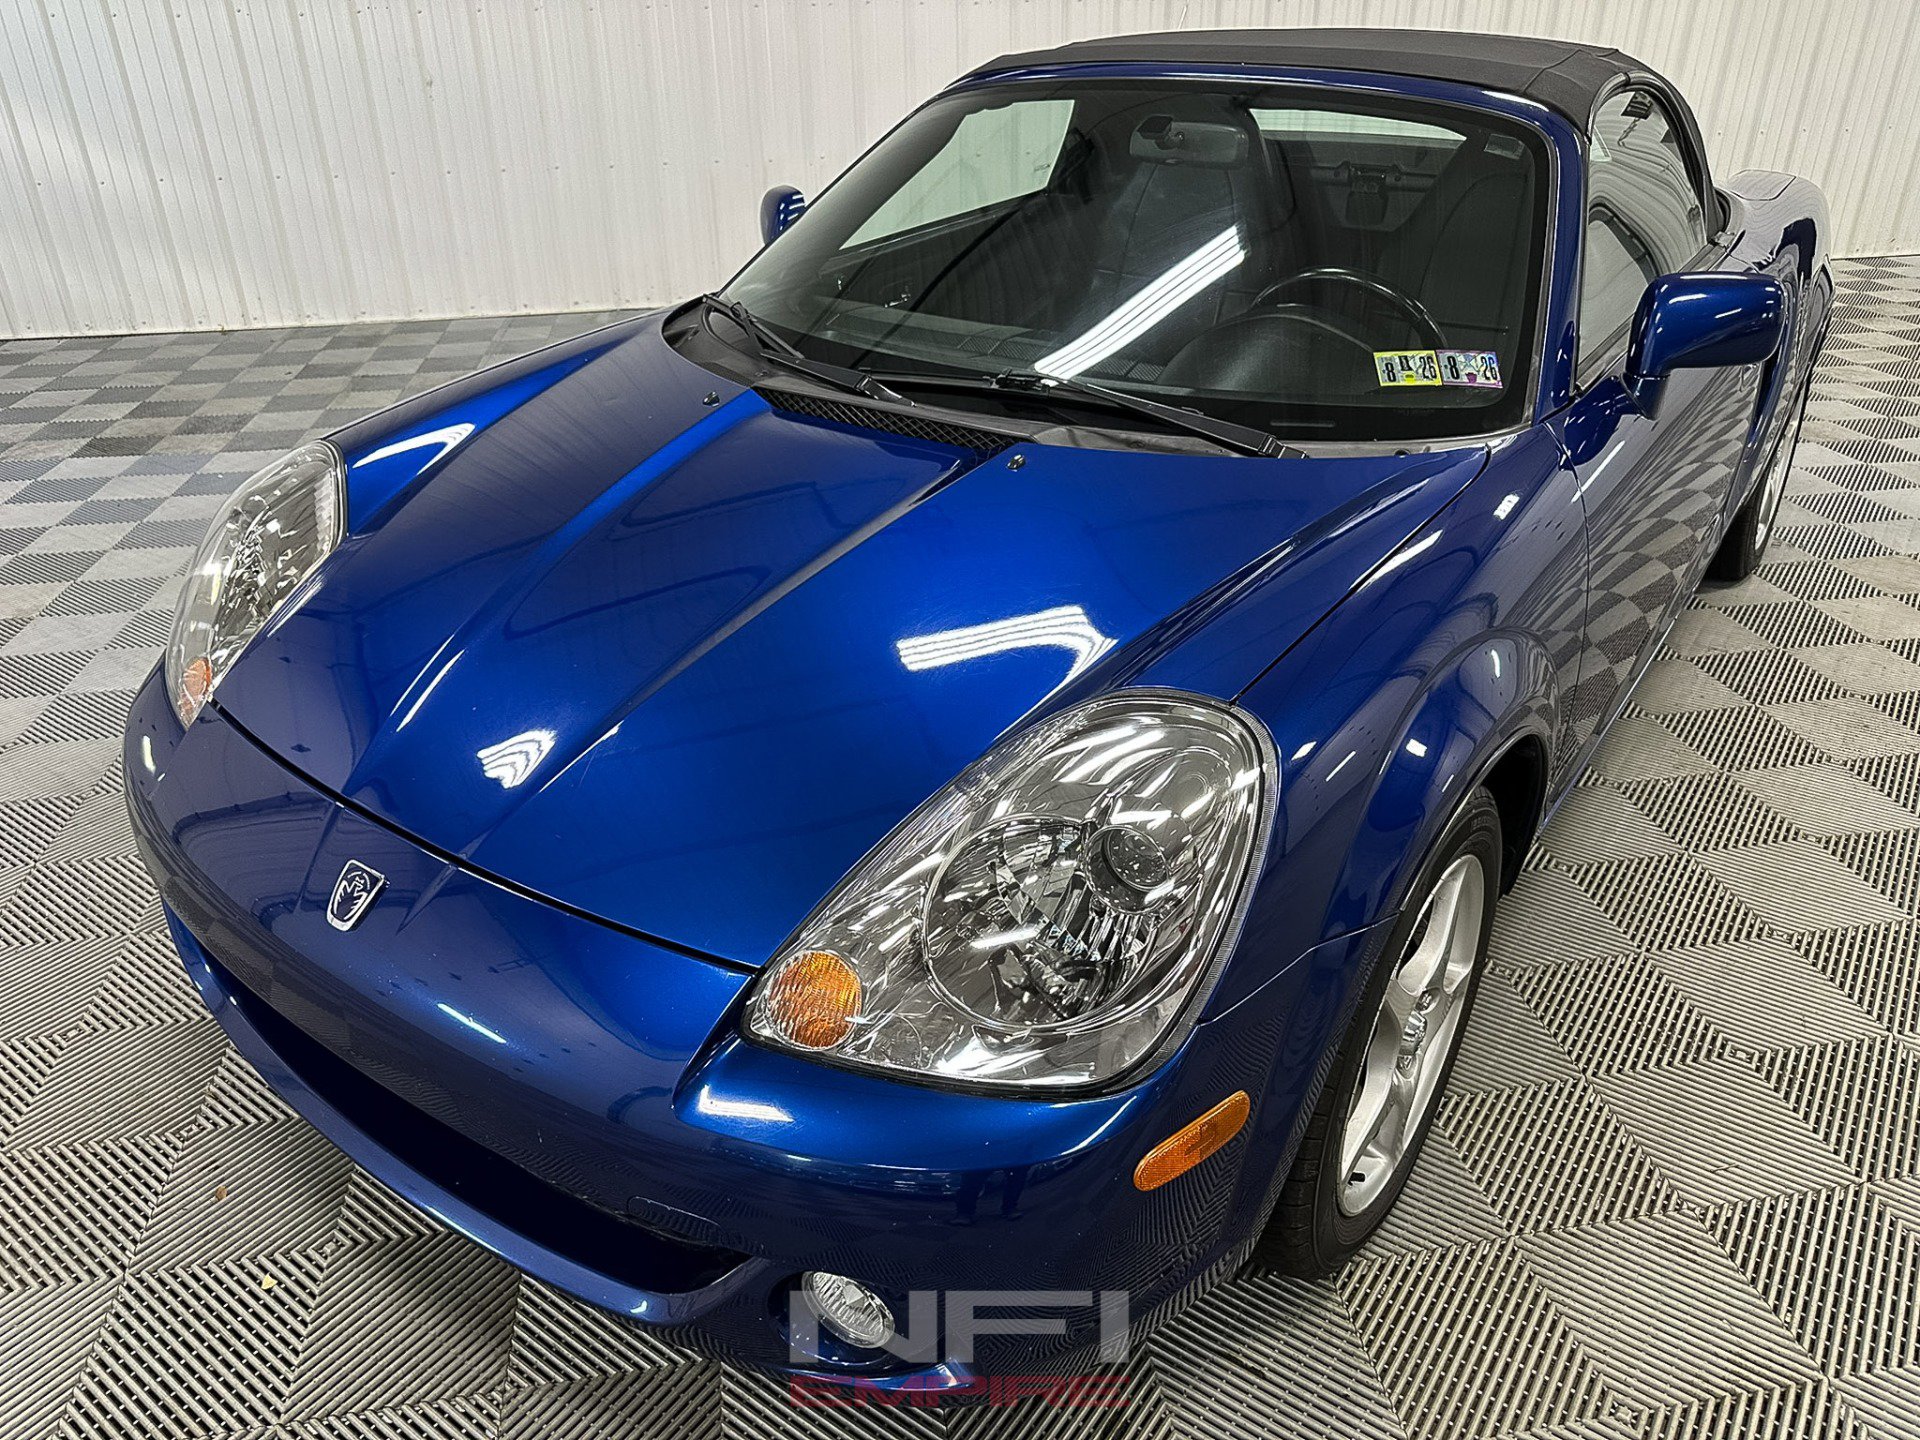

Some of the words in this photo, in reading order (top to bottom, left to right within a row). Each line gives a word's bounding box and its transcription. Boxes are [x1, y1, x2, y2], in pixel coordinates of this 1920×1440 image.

[1385, 362, 1396, 382] 8
[1446, 355, 1460, 380] 8
[1481, 355, 1498, 381] 26
